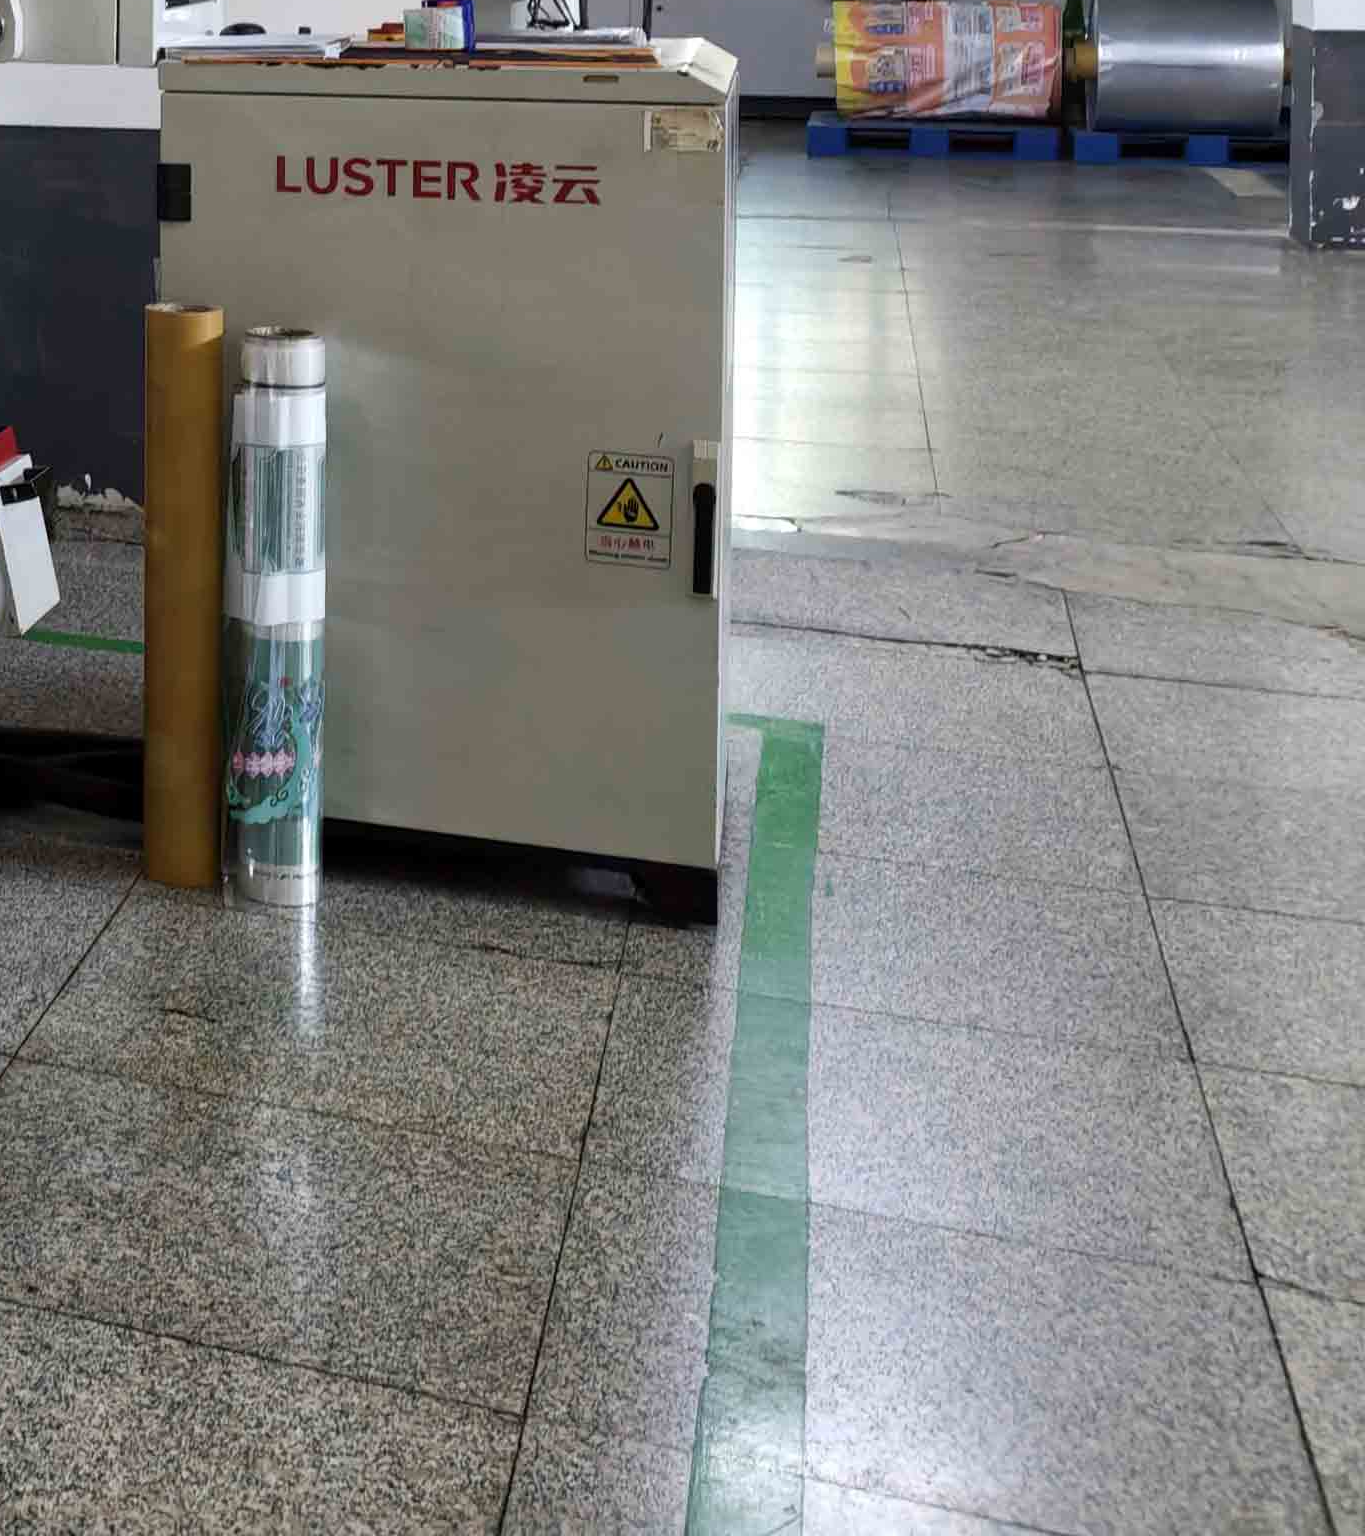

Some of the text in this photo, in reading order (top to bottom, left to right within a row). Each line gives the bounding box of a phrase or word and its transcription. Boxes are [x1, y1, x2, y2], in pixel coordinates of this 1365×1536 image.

[276, 155, 601, 206] LUSTER 凌云
[615, 458, 669, 473] CAUTION
